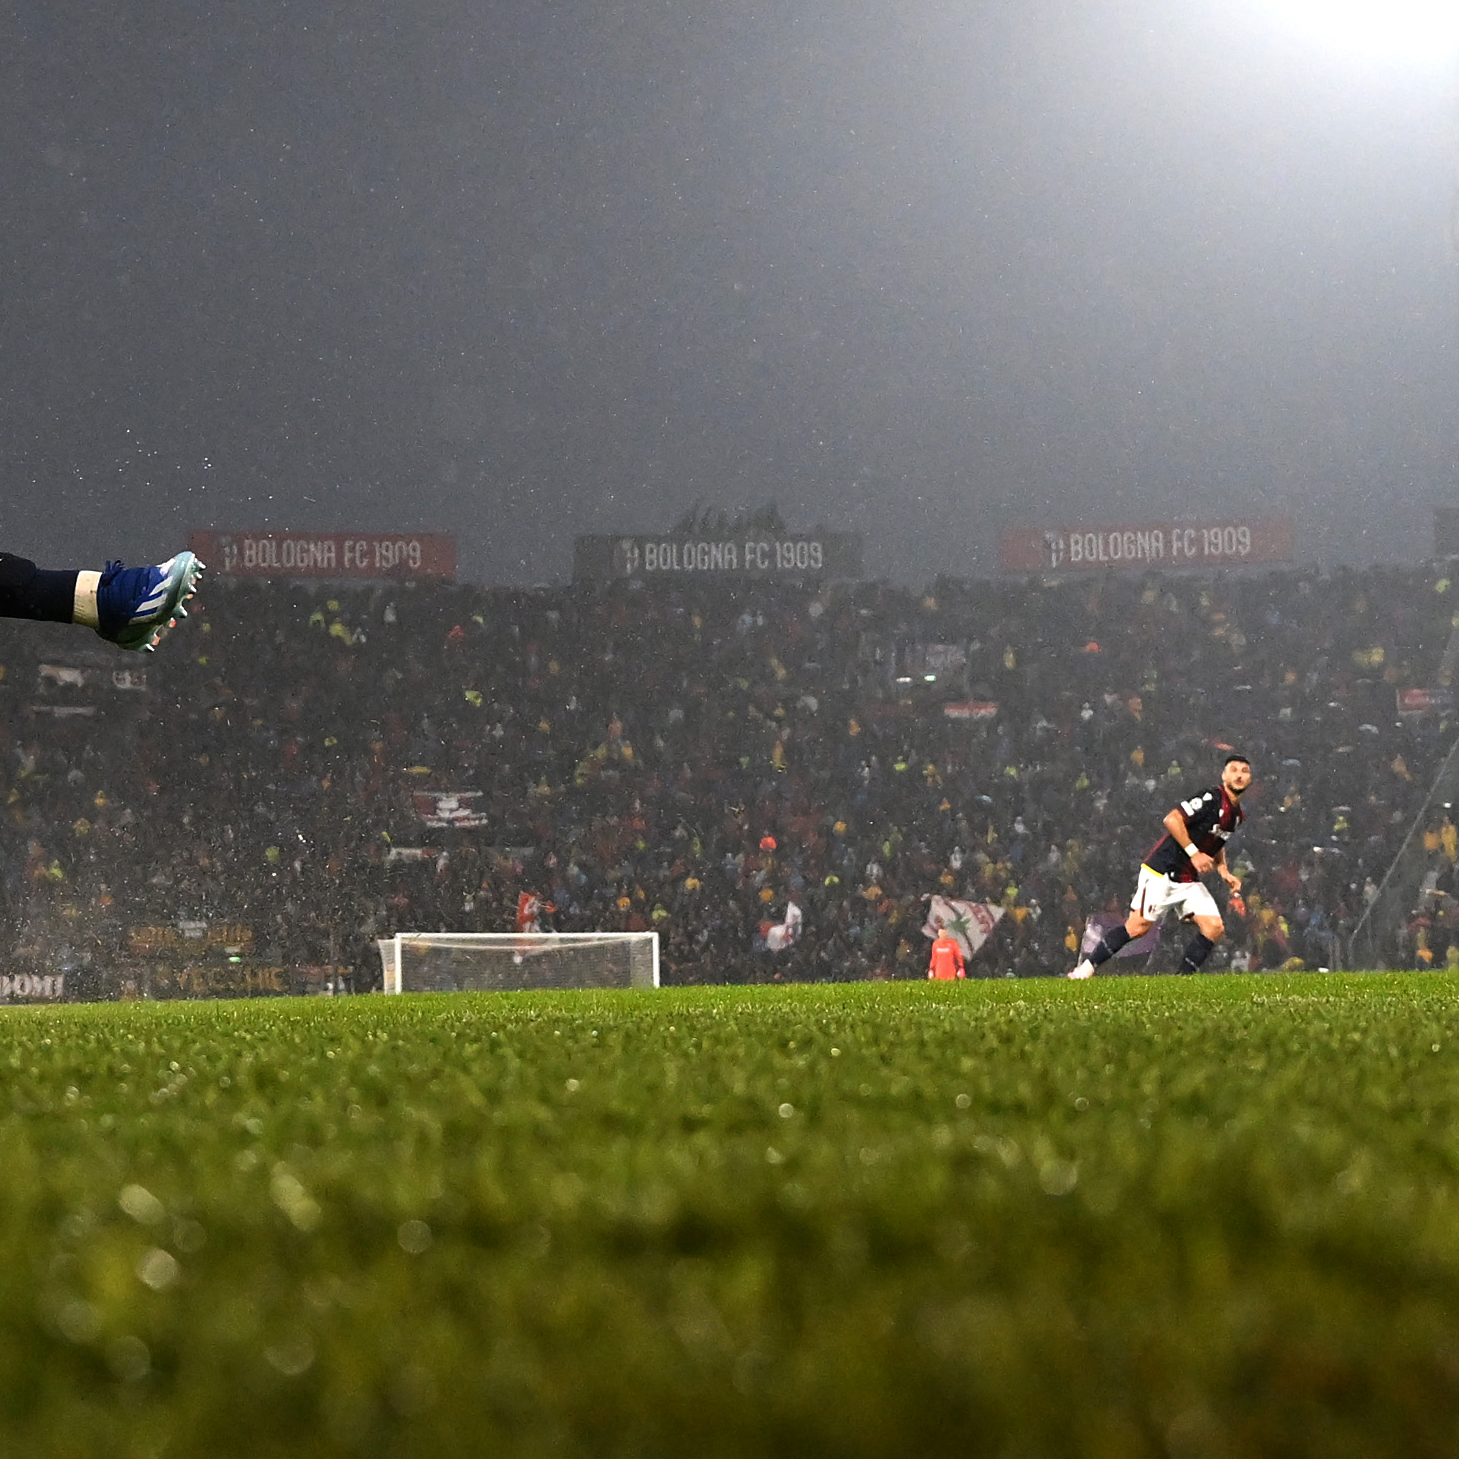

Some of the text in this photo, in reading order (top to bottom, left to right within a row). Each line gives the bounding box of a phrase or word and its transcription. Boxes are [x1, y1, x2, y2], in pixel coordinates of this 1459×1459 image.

[244, 539, 421, 569] BOLOGNA FC 1909
[645, 541, 823, 571] BOLOGNA FC 1909
[1070, 526, 1251, 562] BOLOGNA FC 1909
